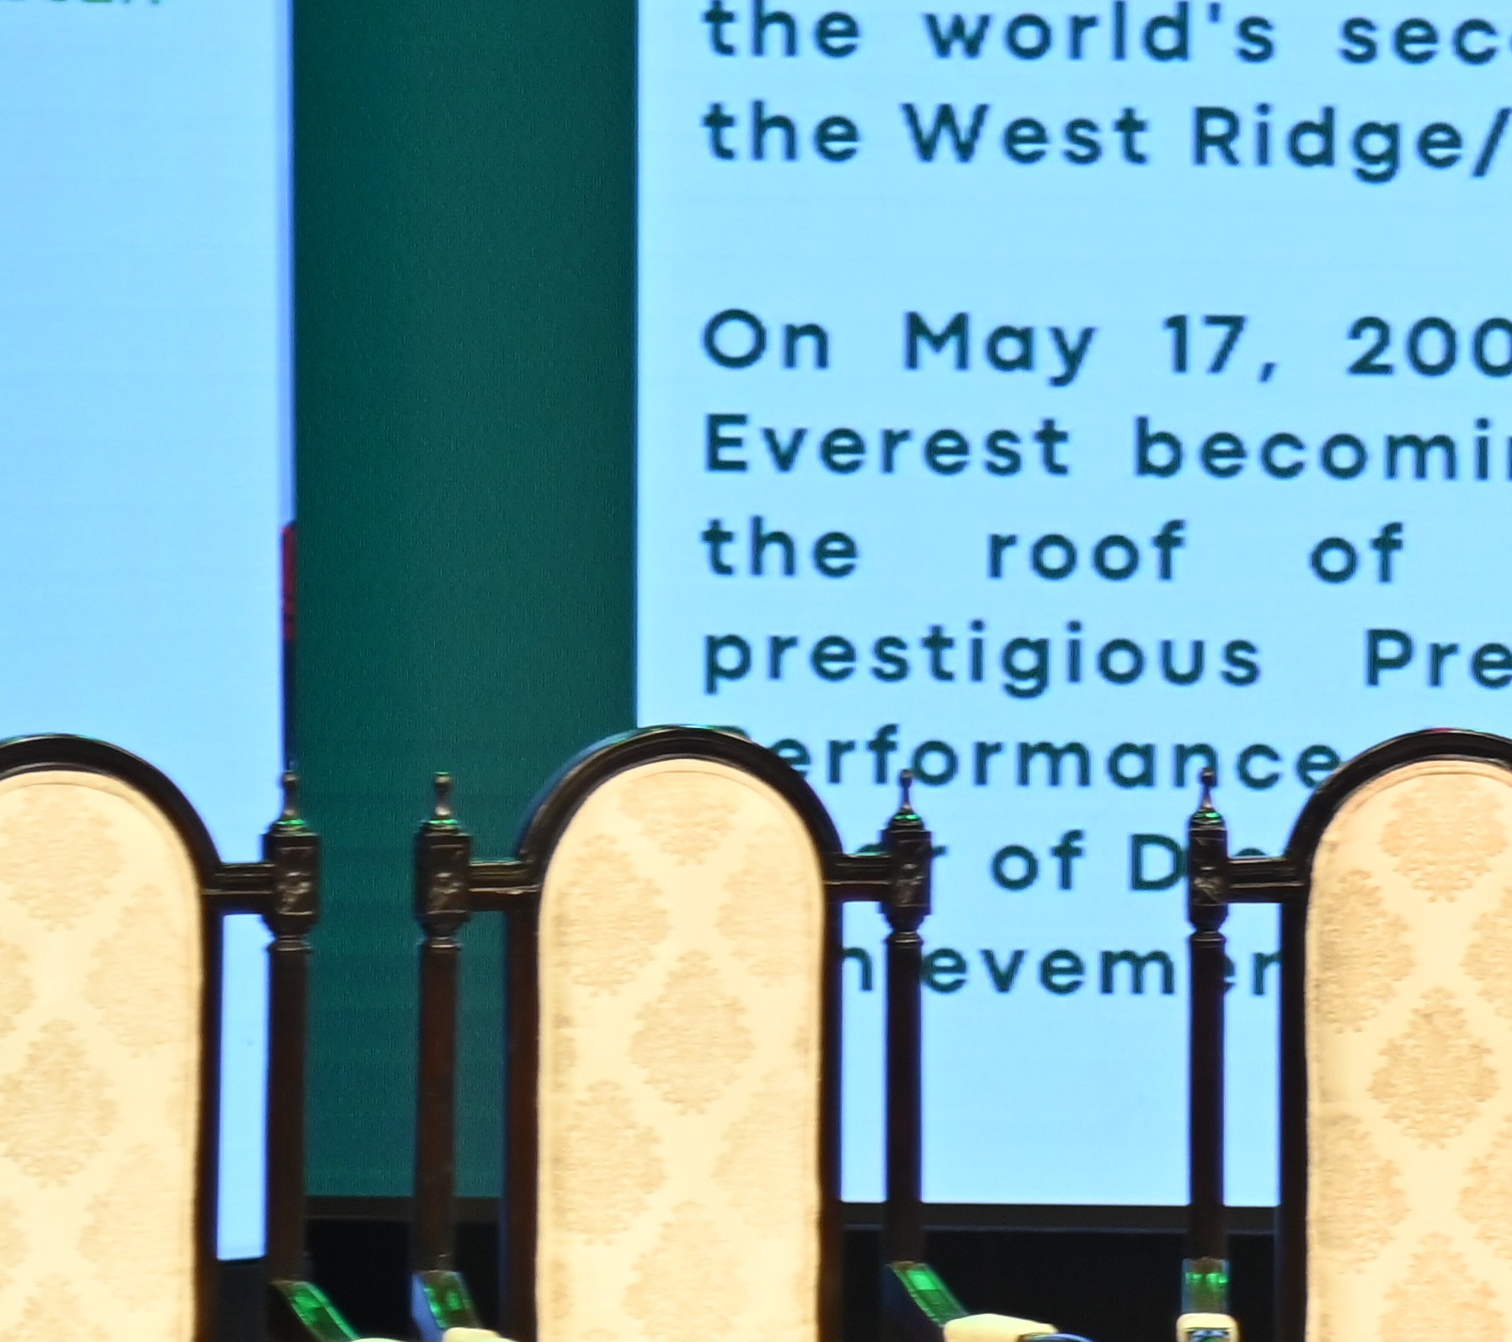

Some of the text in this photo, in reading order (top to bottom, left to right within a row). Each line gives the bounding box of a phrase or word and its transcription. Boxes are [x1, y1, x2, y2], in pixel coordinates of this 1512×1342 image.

[699, 97, 863, 166] the
[899, 100, 1151, 168] West
[700, 306, 832, 372] On
[902, 309, 1098, 390] May
[1161, 312, 1278, 385] 17,
[703, 411, 1071, 480] Everest
[698, 513, 861, 582] the
[986, 517, 1188, 584] roof
[1307, 519, 1406, 587] of
[702, 617, 1263, 703] prestigious
[712, 725, 1343, 791] erformance
[988, 829, 1087, 892] of
